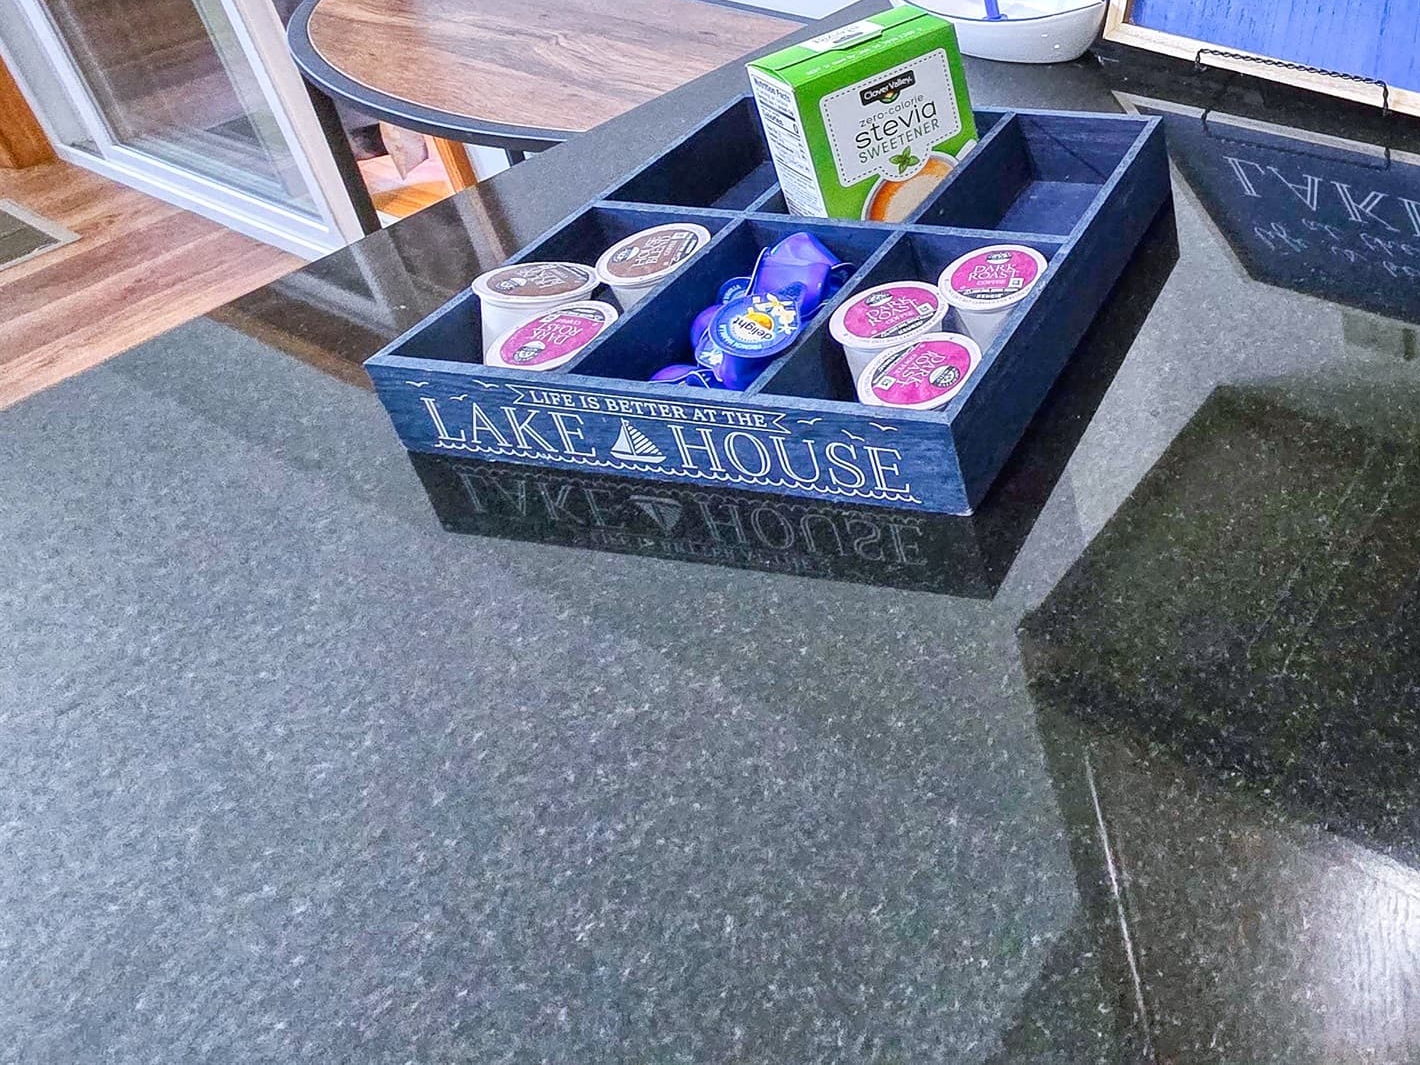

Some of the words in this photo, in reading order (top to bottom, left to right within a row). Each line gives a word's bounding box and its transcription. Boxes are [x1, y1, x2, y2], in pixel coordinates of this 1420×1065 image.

[855, 100, 937, 149] stevia
[859, 94, 924, 128] zero-calorie
[859, 118, 940, 164] SWEETENER
[968, 269, 1019, 281] ROAST
[974, 263, 1017, 274] DARK
[866, 296, 911, 321] DARK
[868, 298, 917, 326] ROAST
[733, 317, 772, 340] delight
[529, 390, 575, 408] LIFE
[581, 396, 601, 411] IS
[605, 398, 687, 420] BETTER
[692, 409, 717, 423] AT
[721, 412, 768, 428] THE
[420, 397, 596, 457] LAKE
[667, 424, 910, 494] HOUSE
